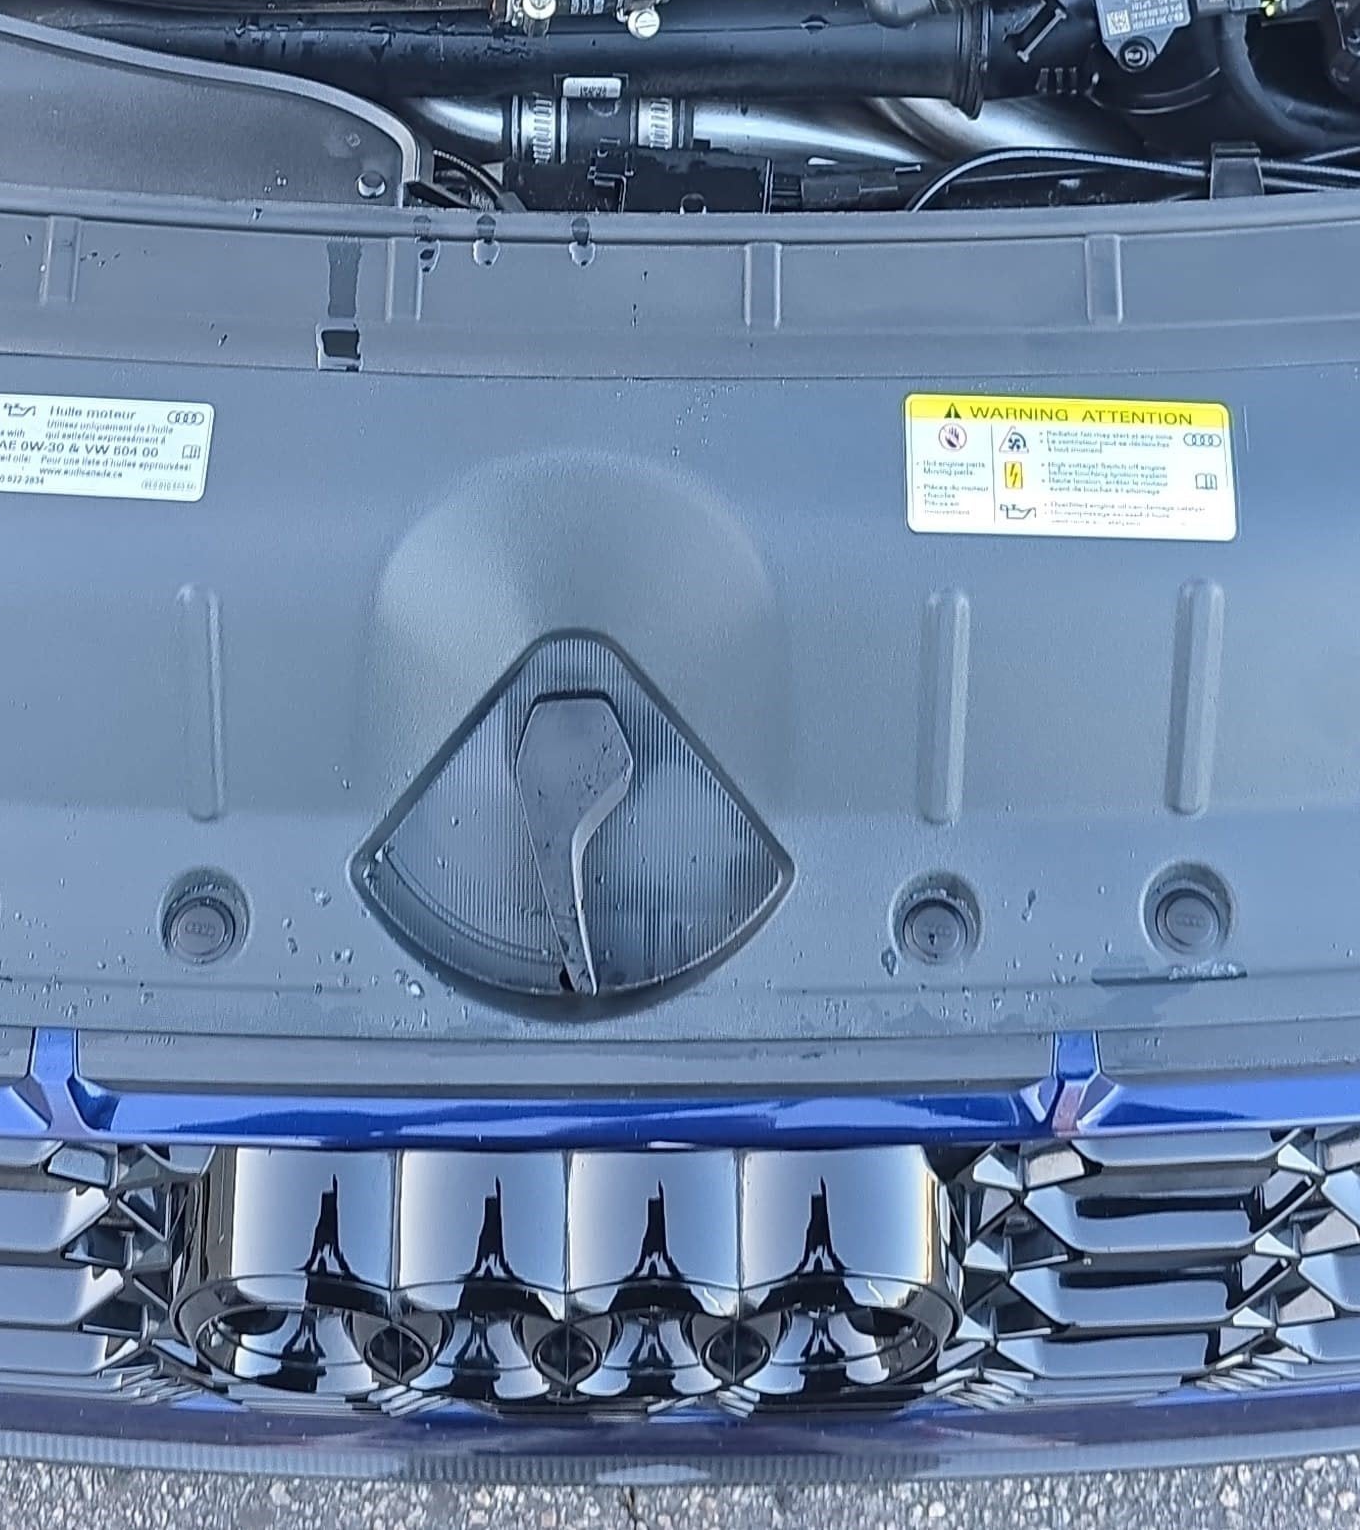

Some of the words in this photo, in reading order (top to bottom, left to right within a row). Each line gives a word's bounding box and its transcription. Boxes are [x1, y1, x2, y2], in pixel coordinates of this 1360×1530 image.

[86, 408, 137, 420] moteur
[970, 405, 1069, 422] WARNING
[1081, 409, 1193, 427] ATTENTION
[20, 440, 65, 454] 0W-30
[84, 443, 111, 456] VW
[142, 446, 160, 458] 00
